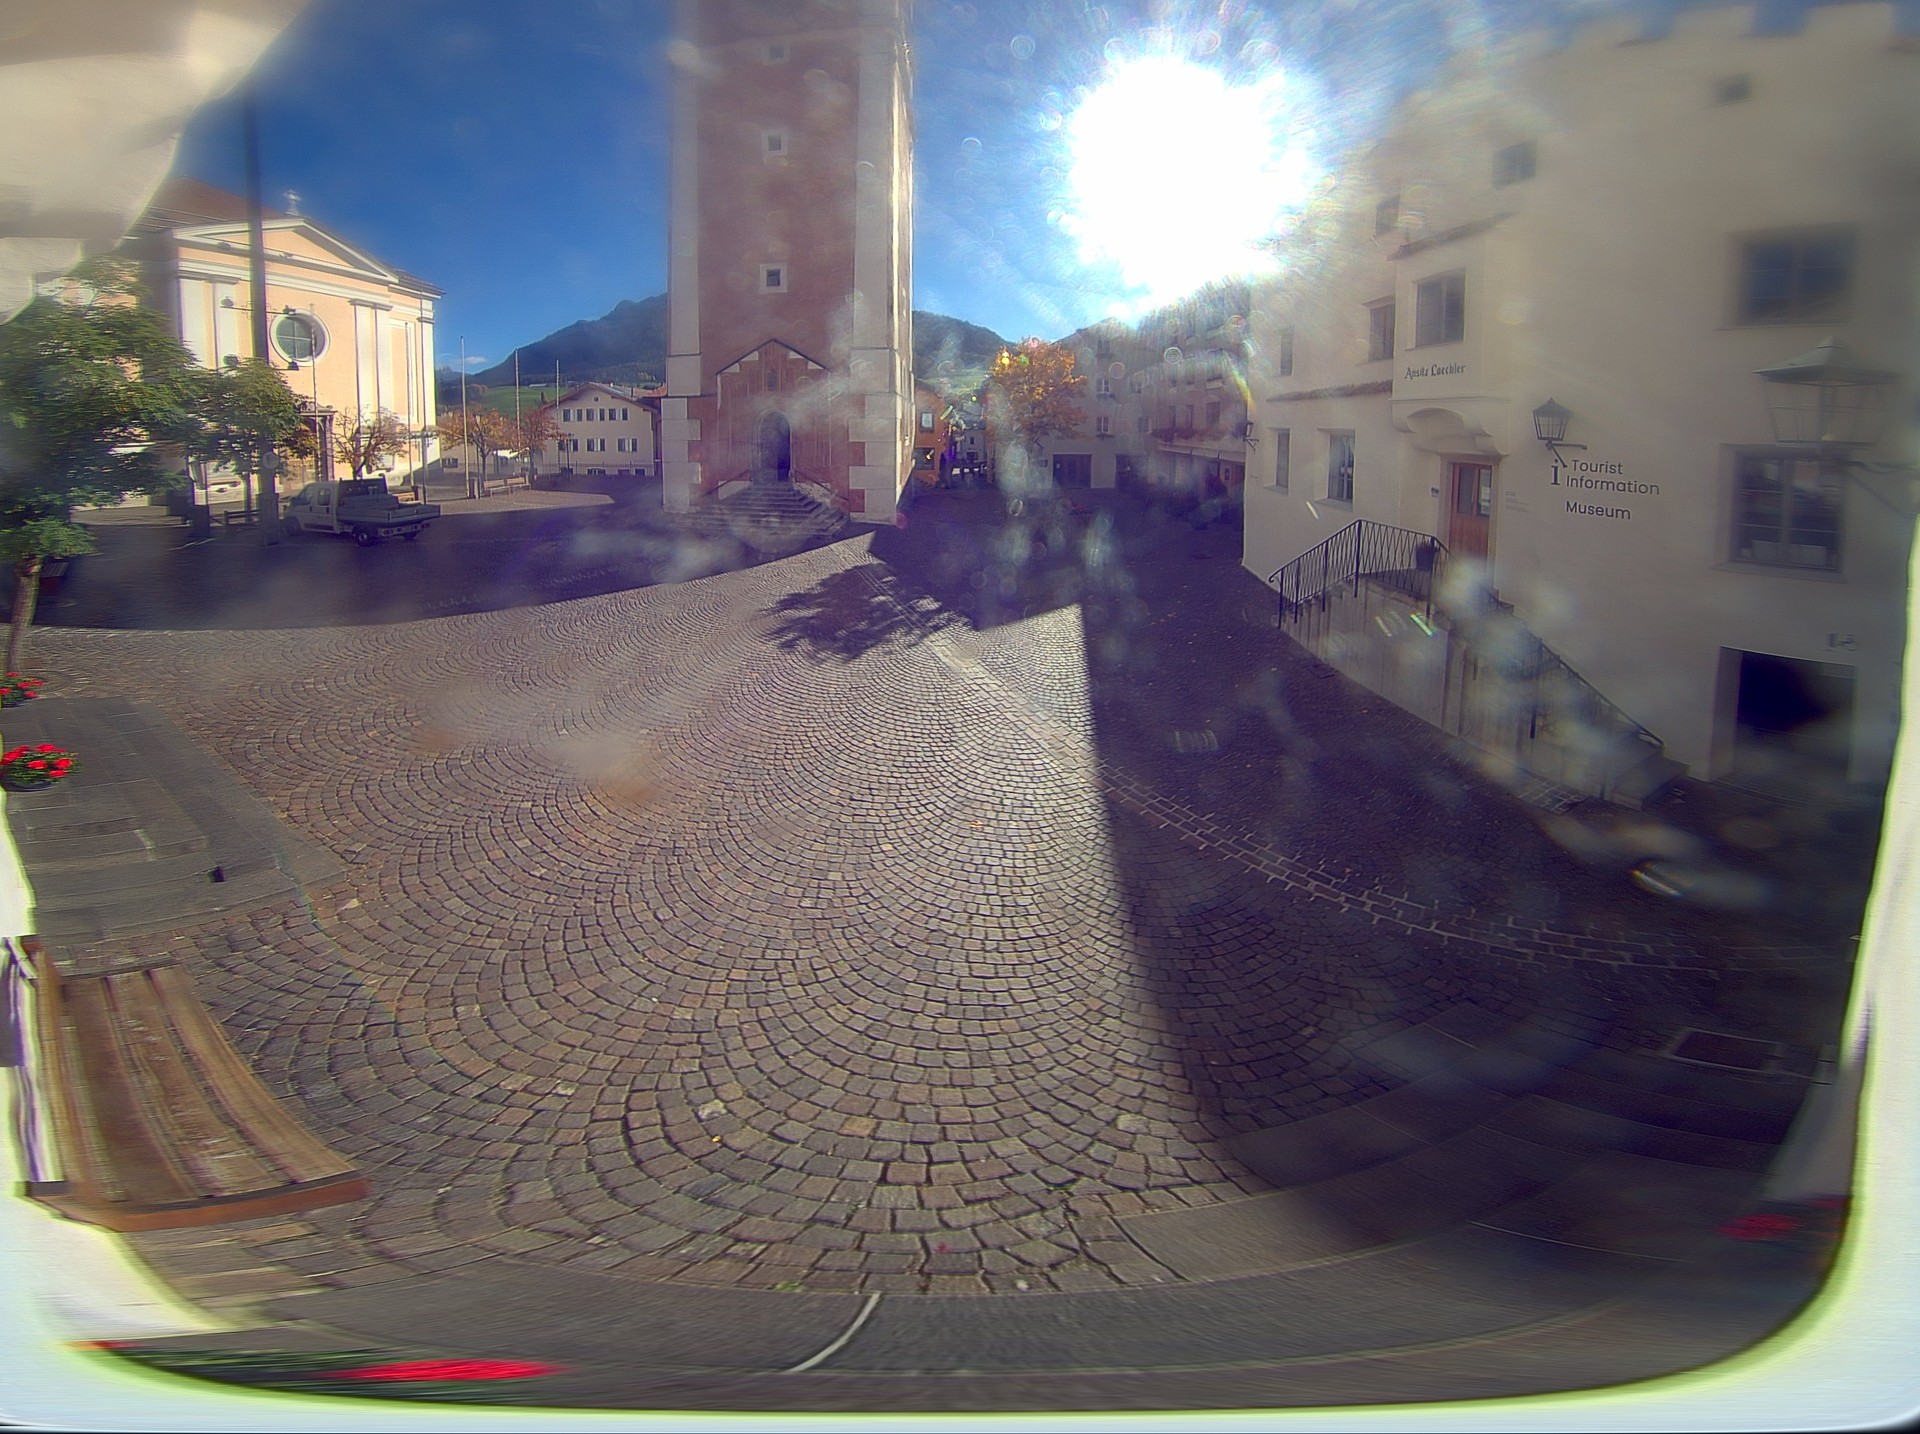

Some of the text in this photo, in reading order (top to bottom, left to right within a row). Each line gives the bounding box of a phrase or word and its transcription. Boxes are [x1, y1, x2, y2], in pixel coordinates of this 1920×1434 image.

[1551, 459, 1560, 486] i
[1571, 459, 1624, 475] Tourist
[1566, 475, 1660, 496] Information
[1566, 500, 1631, 520] Museum
